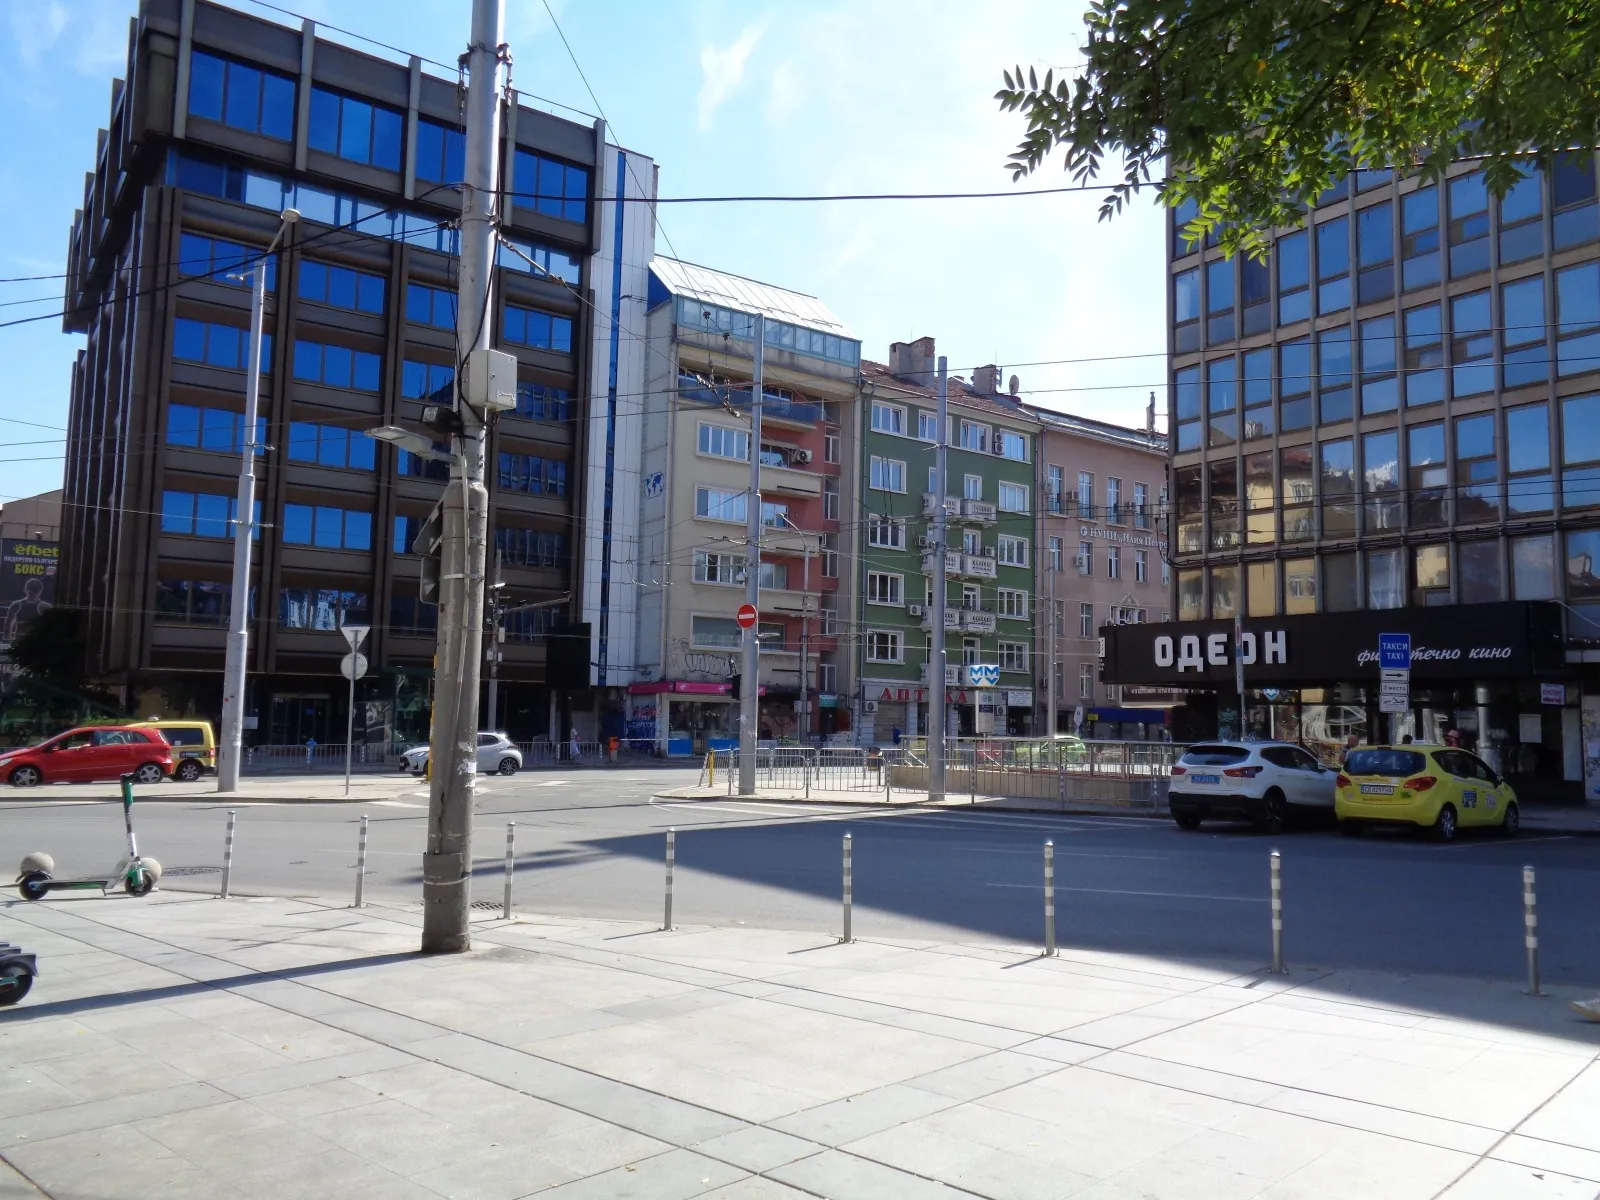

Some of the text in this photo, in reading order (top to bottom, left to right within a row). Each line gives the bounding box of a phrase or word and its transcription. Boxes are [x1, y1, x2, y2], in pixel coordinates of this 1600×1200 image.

[1090, 528, 1117, 541] НУИИ
[14, 545, 60, 557] efbet
[14, 563, 44, 575] БОКС
[1154, 630, 1287, 672] ОДЕОН
[1381, 642, 1408, 650] ТАКСИ
[1357, 646, 1512, 667] фитечно кино
[1386, 652, 1404, 660] TAXI
[880, 687, 967, 704] АПТКА
